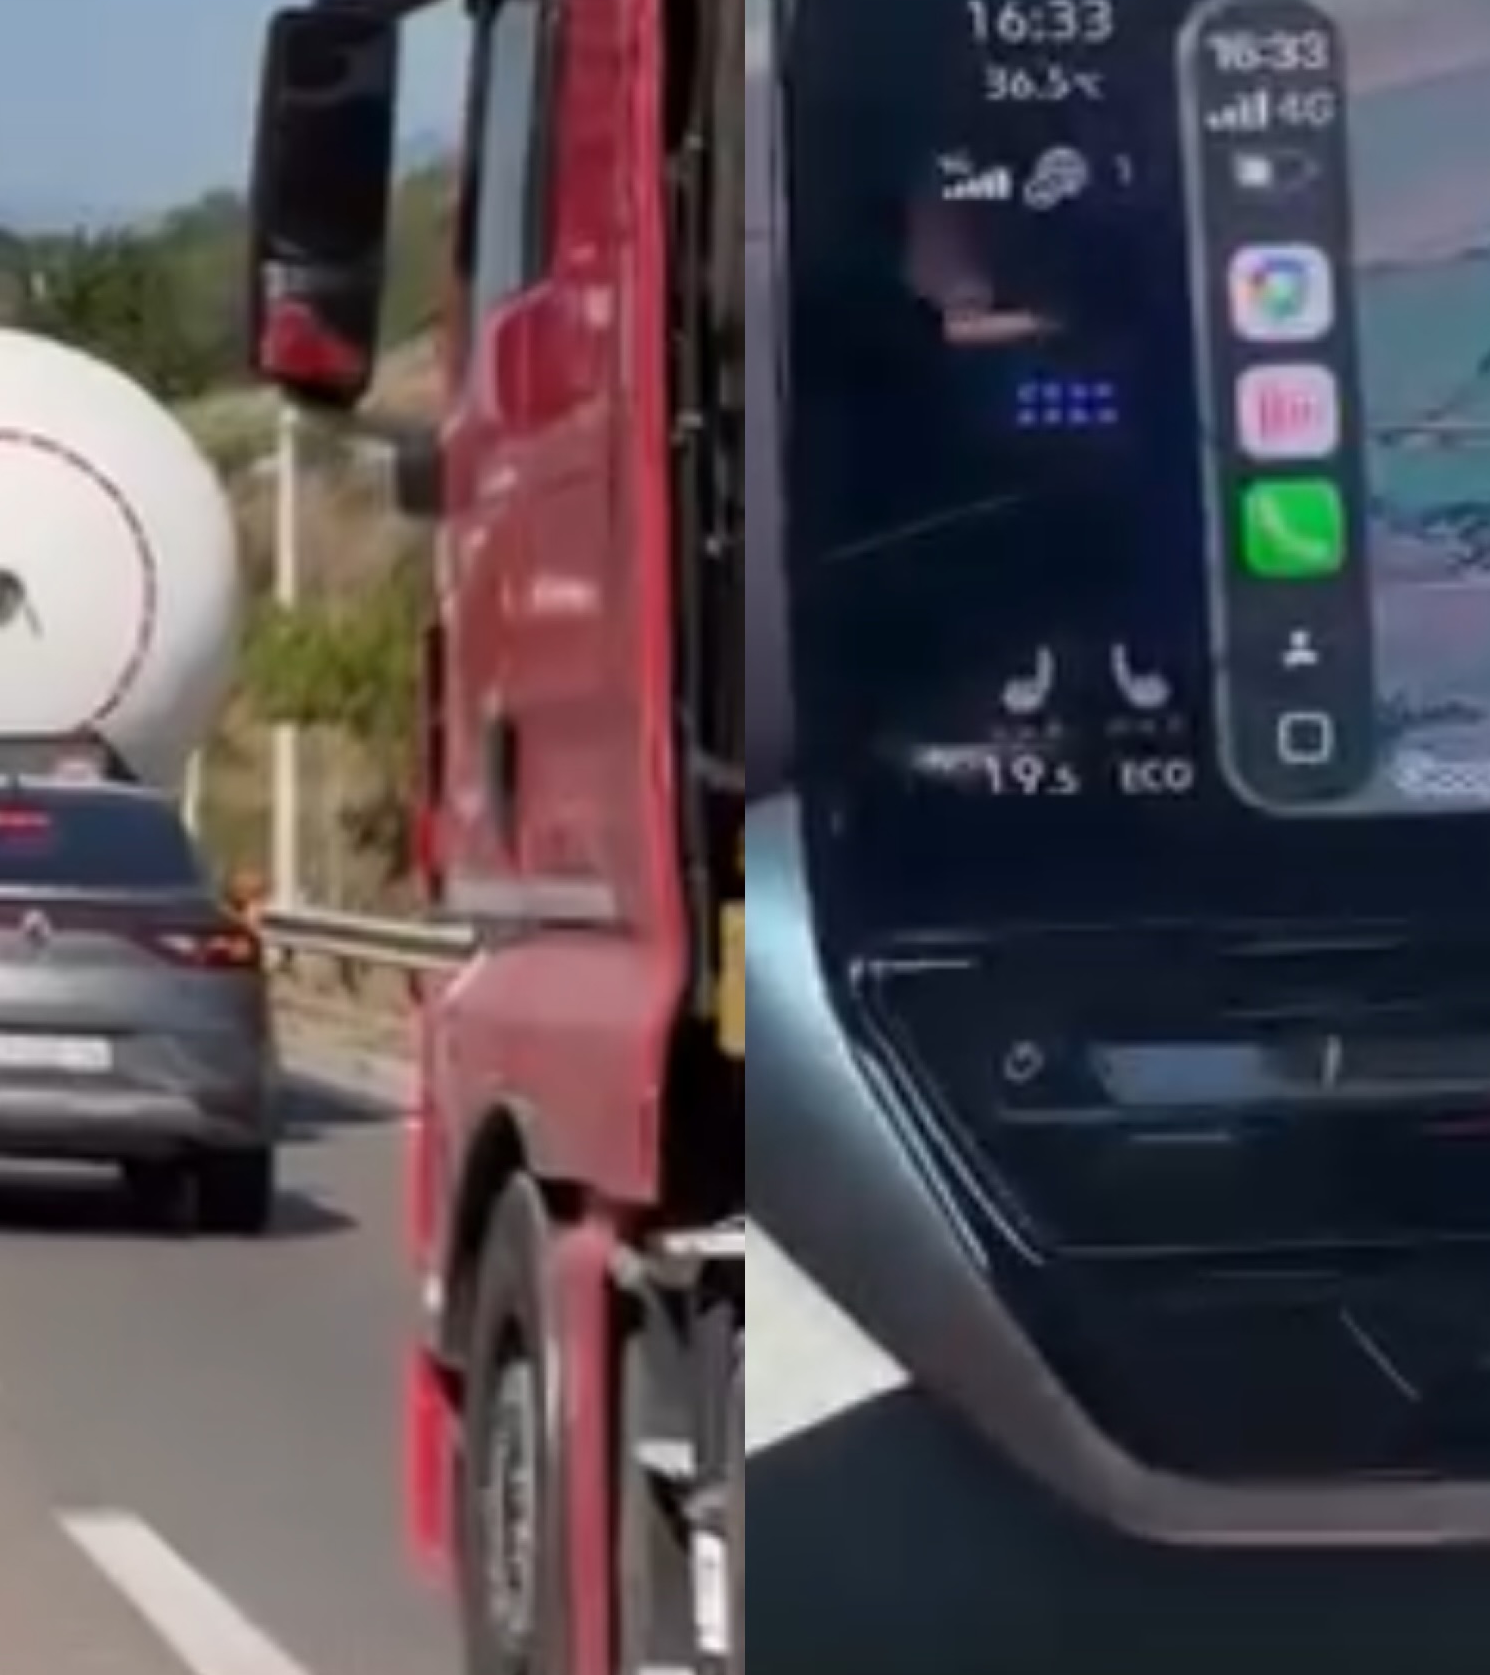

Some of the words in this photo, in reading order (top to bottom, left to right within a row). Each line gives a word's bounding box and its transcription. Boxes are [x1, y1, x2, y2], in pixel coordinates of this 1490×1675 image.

[1209, 31, 1331, 72] 16:33
[1277, 91, 1334, 126] 4G
[1120, 756, 1195, 796] ECO
